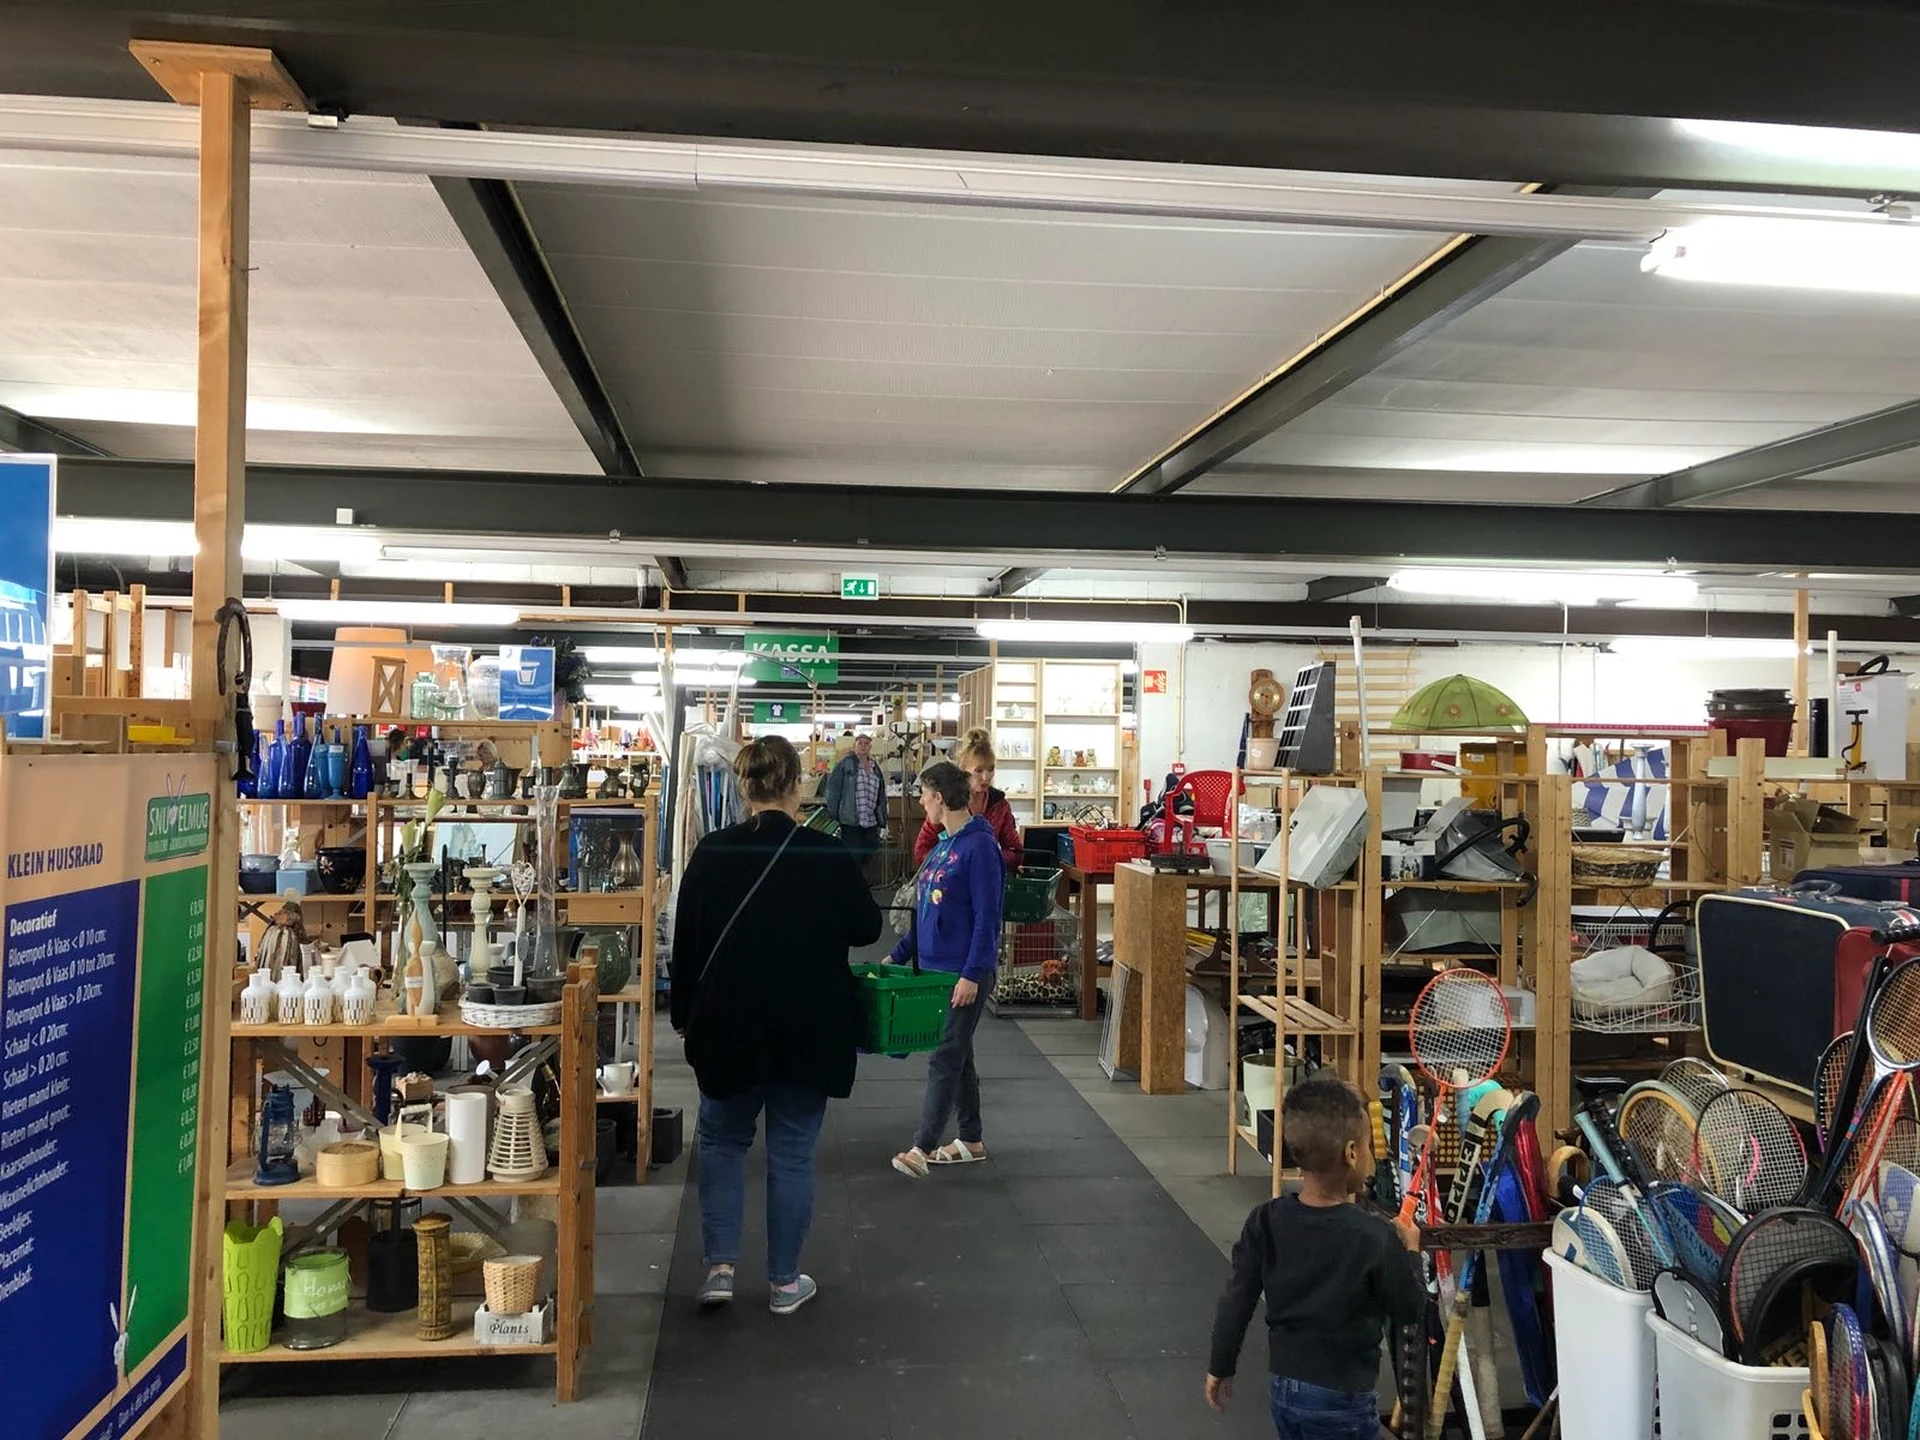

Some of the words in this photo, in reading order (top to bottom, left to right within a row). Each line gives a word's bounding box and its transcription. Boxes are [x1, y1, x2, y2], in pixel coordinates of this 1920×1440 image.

[752, 643, 830, 664] KASSA
[8, 851, 43, 879] KLEIN
[47, 842, 103, 871] HUISRAAD
[10, 908, 57, 937] Decoratief
[8, 943, 46, 967] Bloempot
[46, 939, 53, 957] &
[54, 937, 70, 955] Vaas
[86, 928, 94, 946] 10
[7, 972, 45, 998] Bloempot
[45, 967, 52, 986] &
[52, 965, 69, 984] Vaas
[77, 958, 85, 976] 10
[85, 957, 96, 973] tot
[6, 1002, 43, 1029] Bloempot
[43, 996, 51, 1015] &
[51, 994, 68, 1012] Vaas
[4, 1032, 30, 1060] Schaal
[4, 1062, 29, 1090] Schaal
[2, 1096, 27, 1120] Rieten
[28, 1082, 50, 1108] mand
[1, 1127, 26, 1151] Rieten
[27, 1111, 48, 1137] mand
[489, 1319, 529, 1334] Plants
